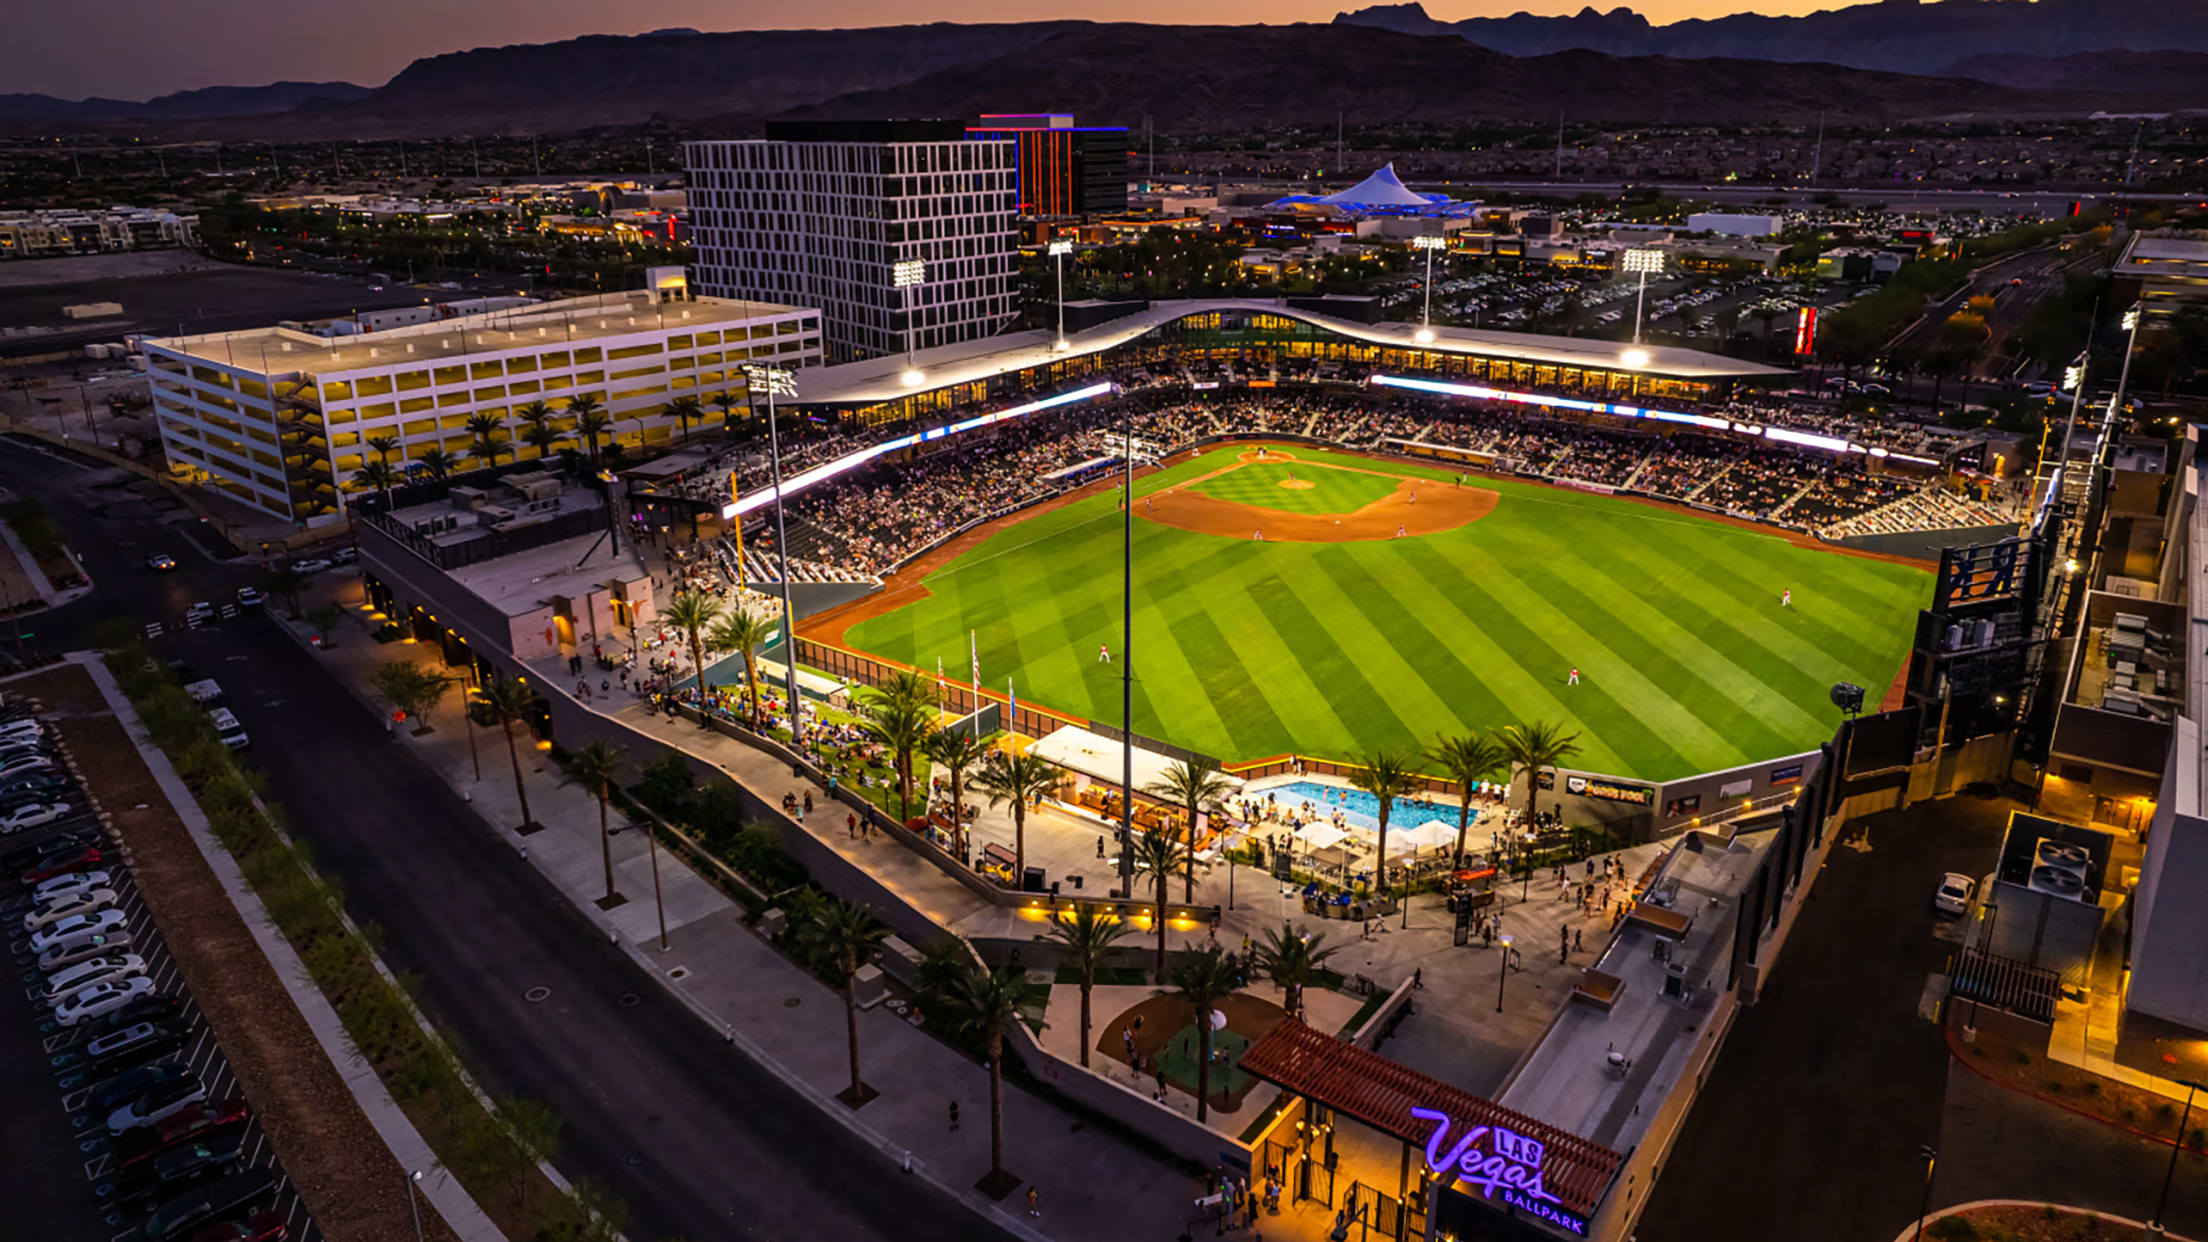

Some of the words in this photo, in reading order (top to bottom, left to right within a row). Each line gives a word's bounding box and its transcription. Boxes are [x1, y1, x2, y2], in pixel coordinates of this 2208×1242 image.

[1410, 1106, 1562, 1204] Vegas
[1500, 1131, 1539, 1164] LAS
[1504, 1189, 1584, 1234] BALLPARK
